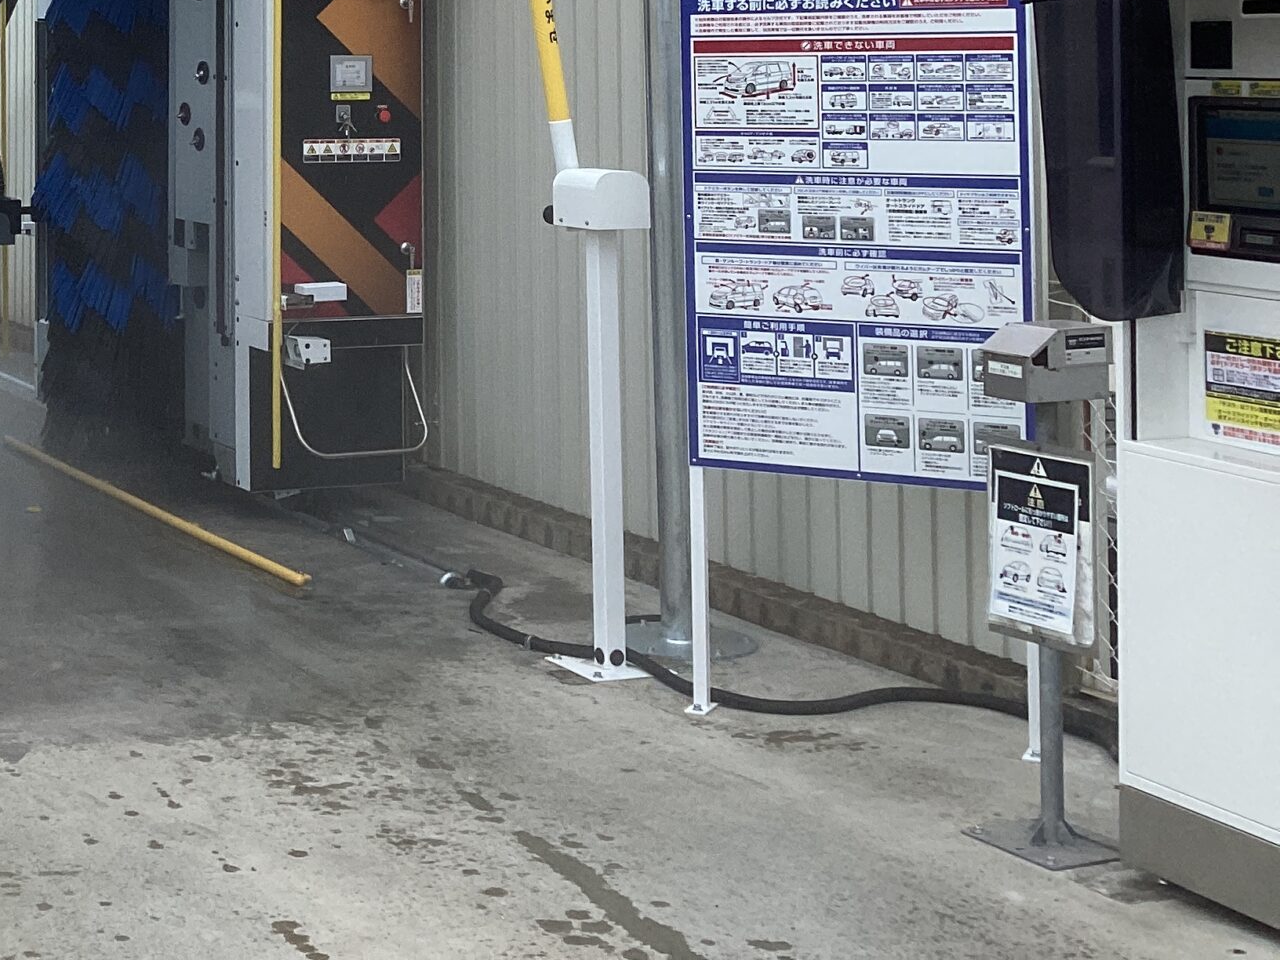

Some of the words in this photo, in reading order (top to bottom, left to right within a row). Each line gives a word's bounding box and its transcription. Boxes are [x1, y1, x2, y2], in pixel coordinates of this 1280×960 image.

[813, 40, 896, 50] 洗車できない車両
